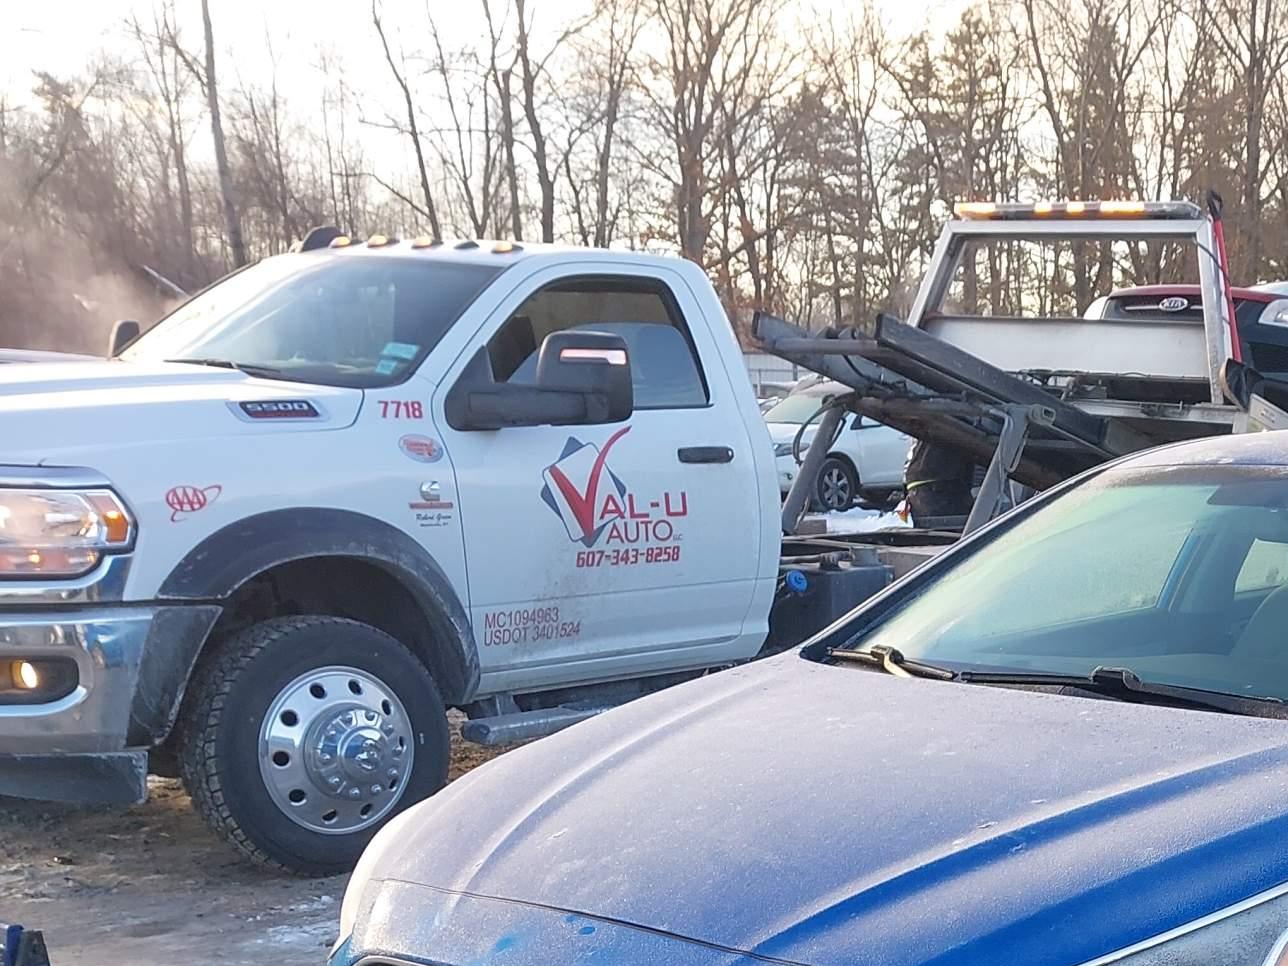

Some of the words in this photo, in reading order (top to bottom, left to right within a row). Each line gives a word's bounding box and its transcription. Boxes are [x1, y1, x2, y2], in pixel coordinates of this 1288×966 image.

[1162, 299, 1185, 309] KIA
[245, 402, 309, 412] 5500
[377, 400, 423, 419] 7718
[167, 487, 206, 511] AAA
[606, 519, 673, 545] AUTO
[576, 546, 681, 568] 607-343-8258
[485, 607, 560, 629] MC1094963
[484, 626, 530, 647] USDOT
[532, 621, 582, 642] 3401524
